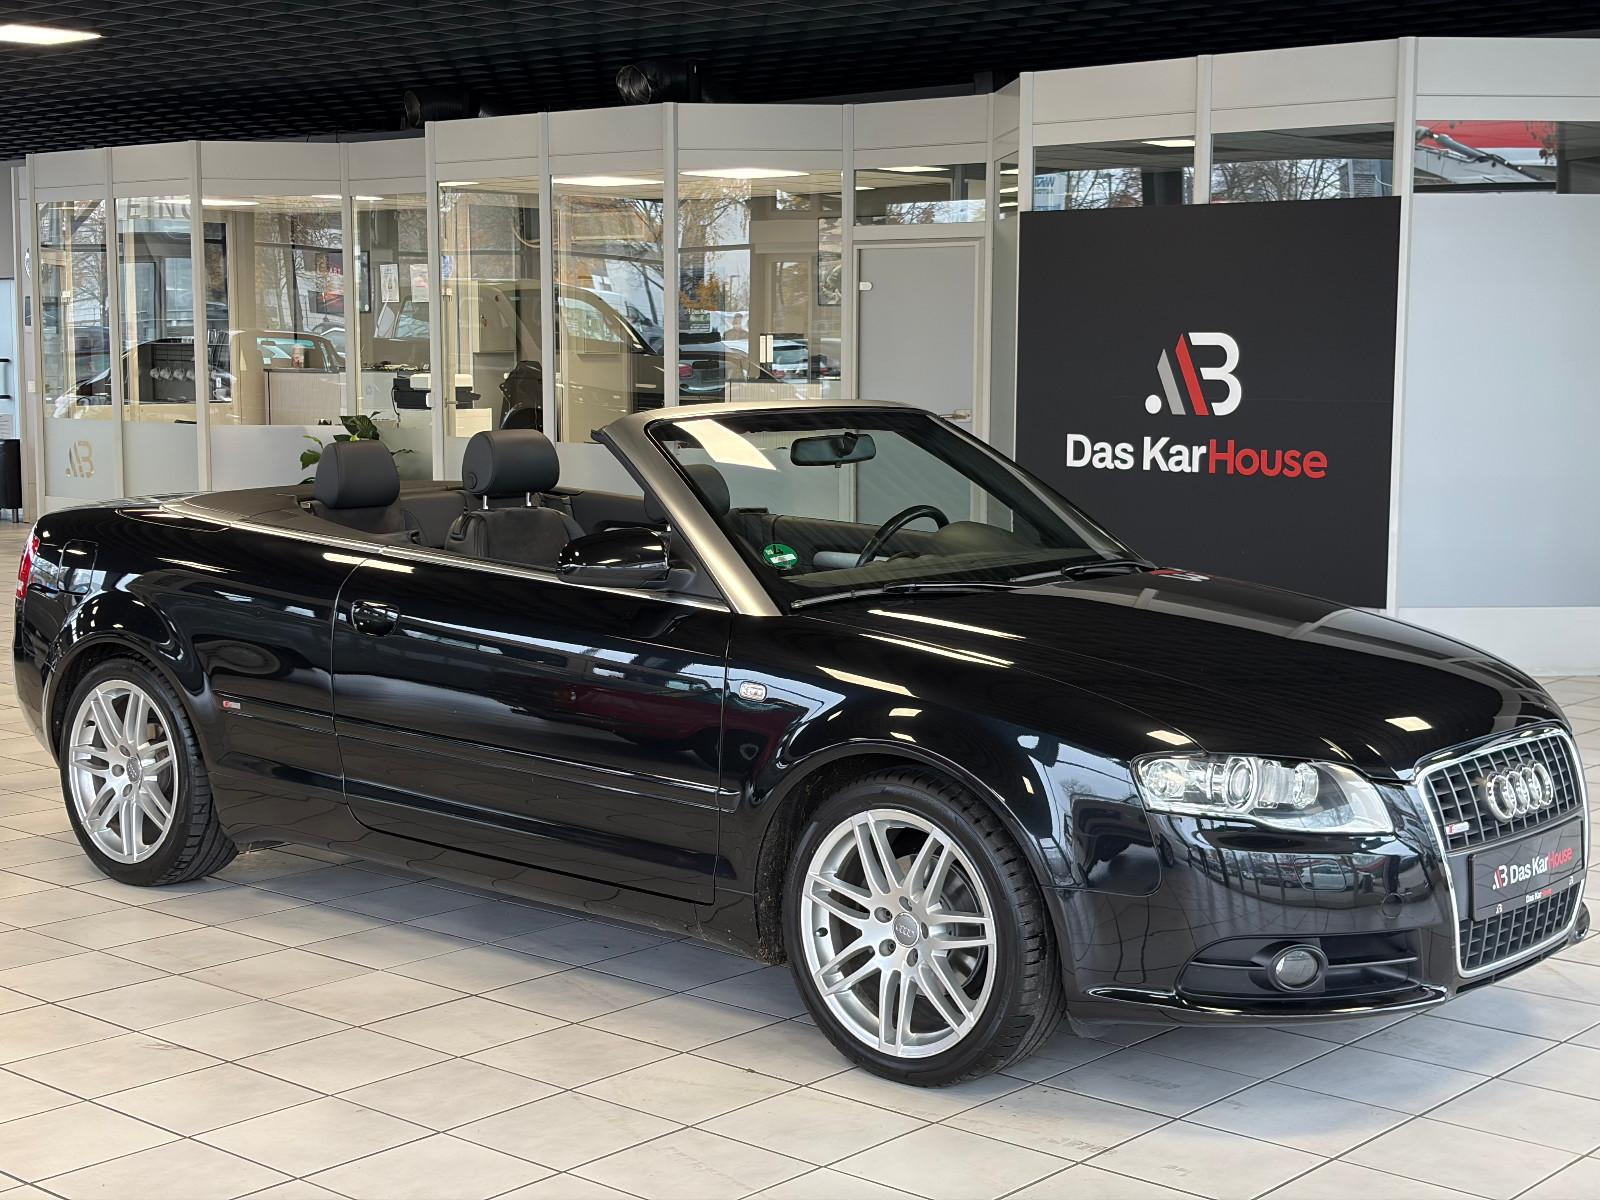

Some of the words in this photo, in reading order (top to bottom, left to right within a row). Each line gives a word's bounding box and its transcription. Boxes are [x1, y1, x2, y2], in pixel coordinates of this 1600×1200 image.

[1066, 433, 1134, 470] Das
[1142, 436, 1328, 479] KarHouse
[1510, 864, 1531, 884] Das
